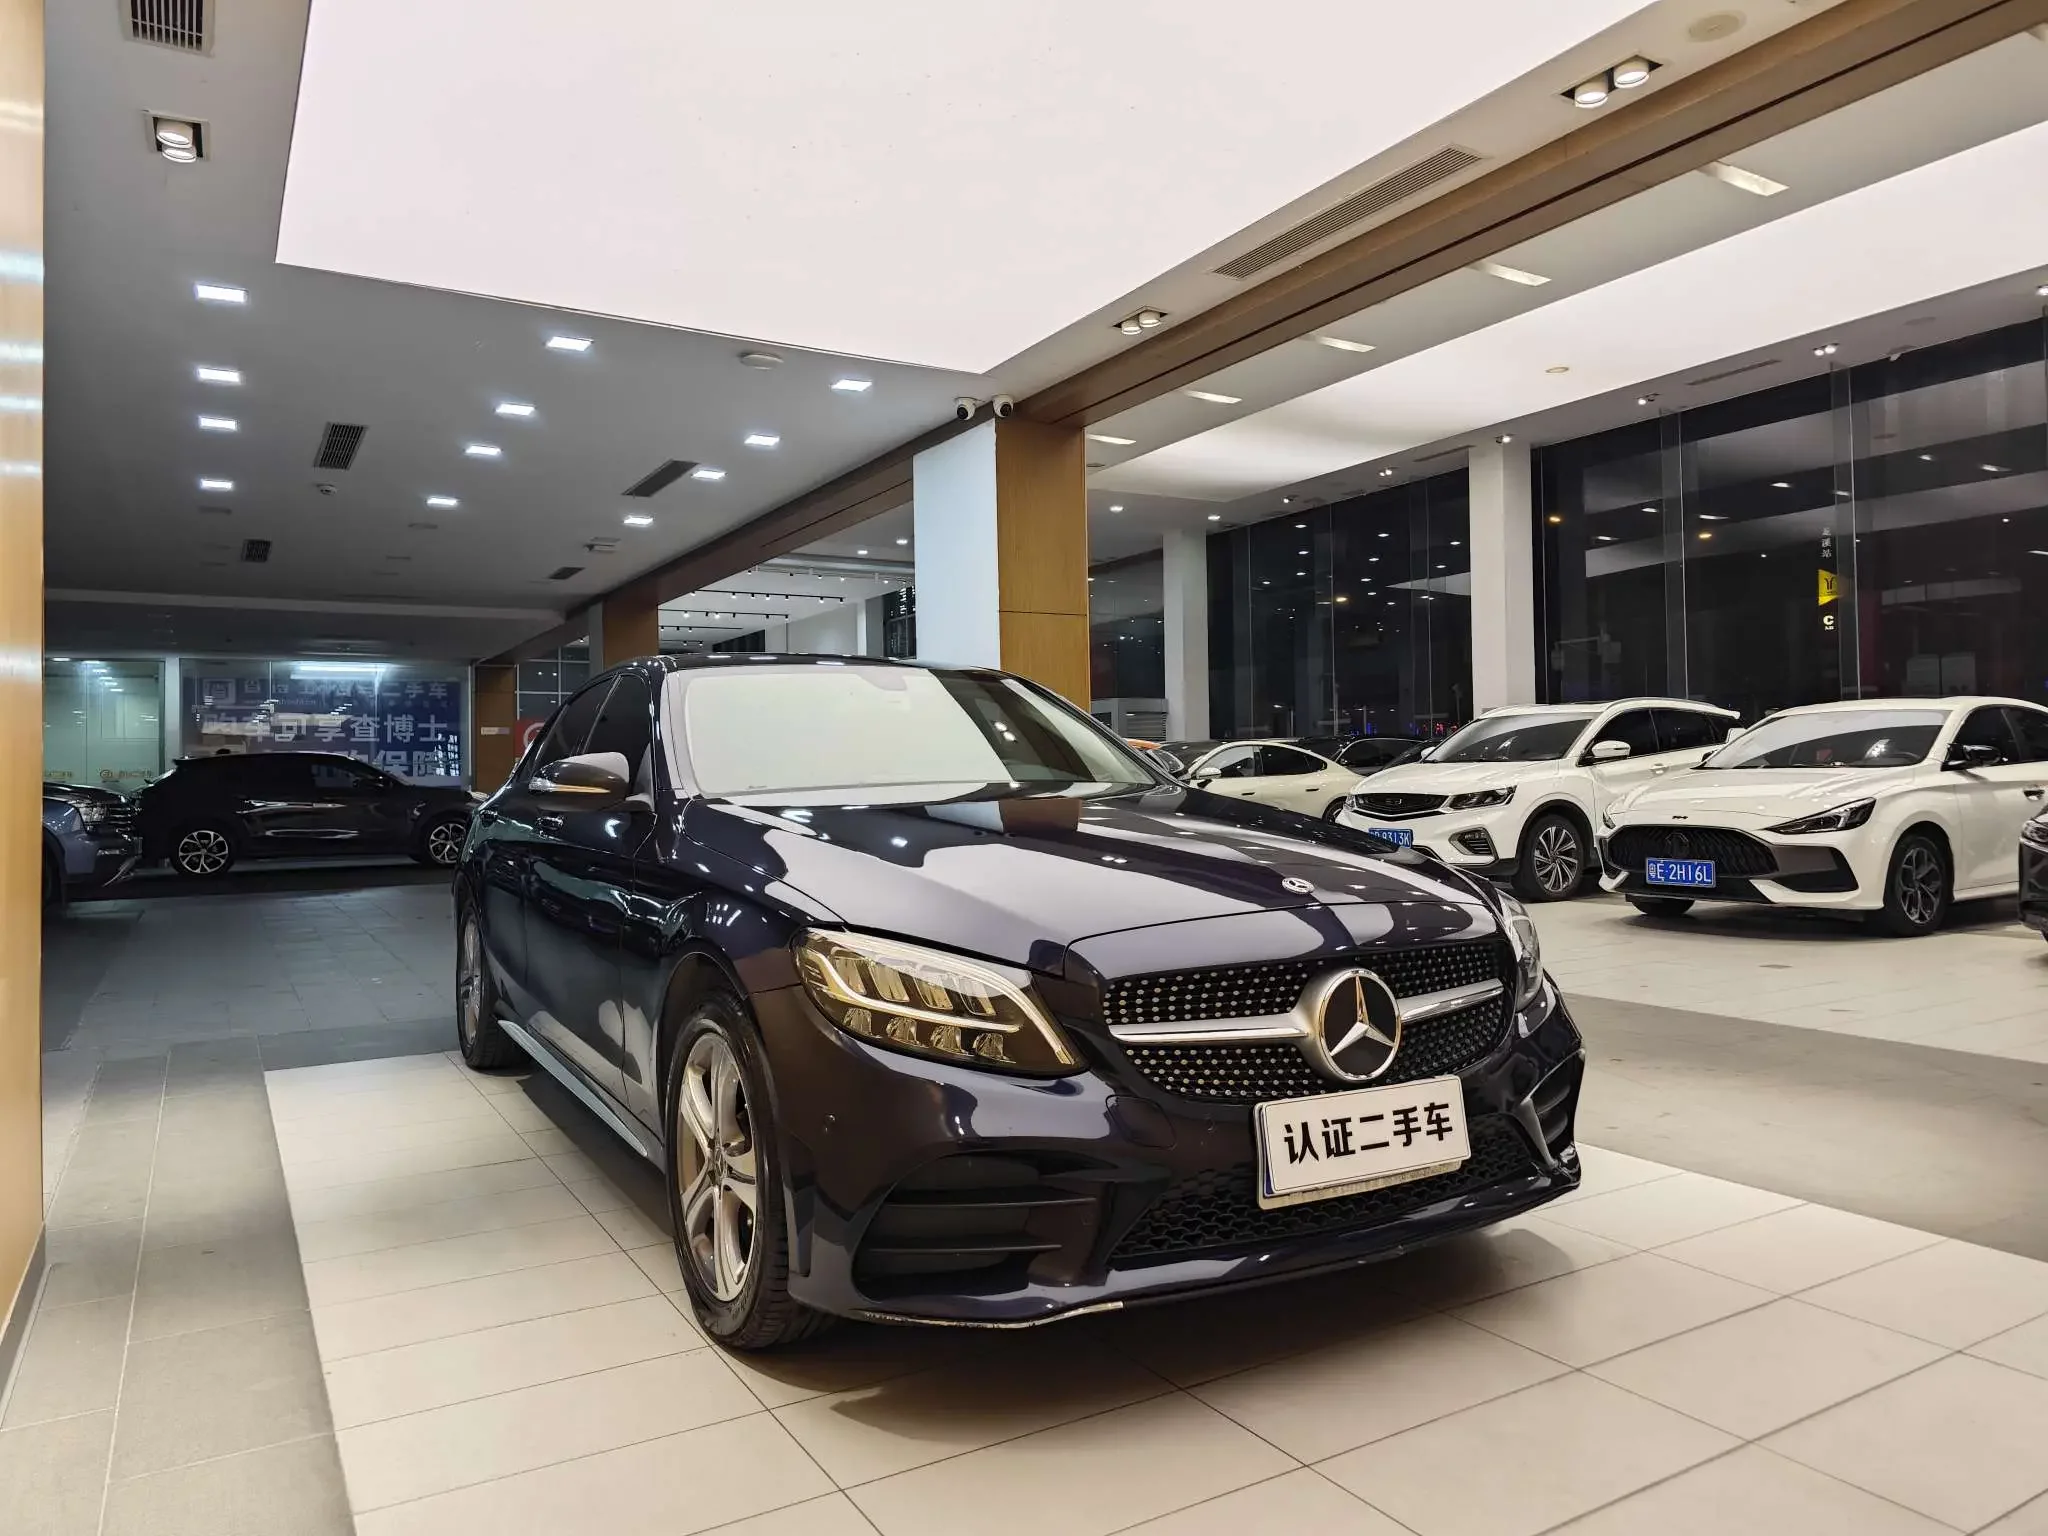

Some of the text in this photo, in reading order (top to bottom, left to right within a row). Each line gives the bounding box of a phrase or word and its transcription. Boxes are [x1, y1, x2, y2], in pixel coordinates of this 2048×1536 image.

[1823, 615, 1834, 625] C
[1284, 1101, 1453, 1164] 认证二手车
